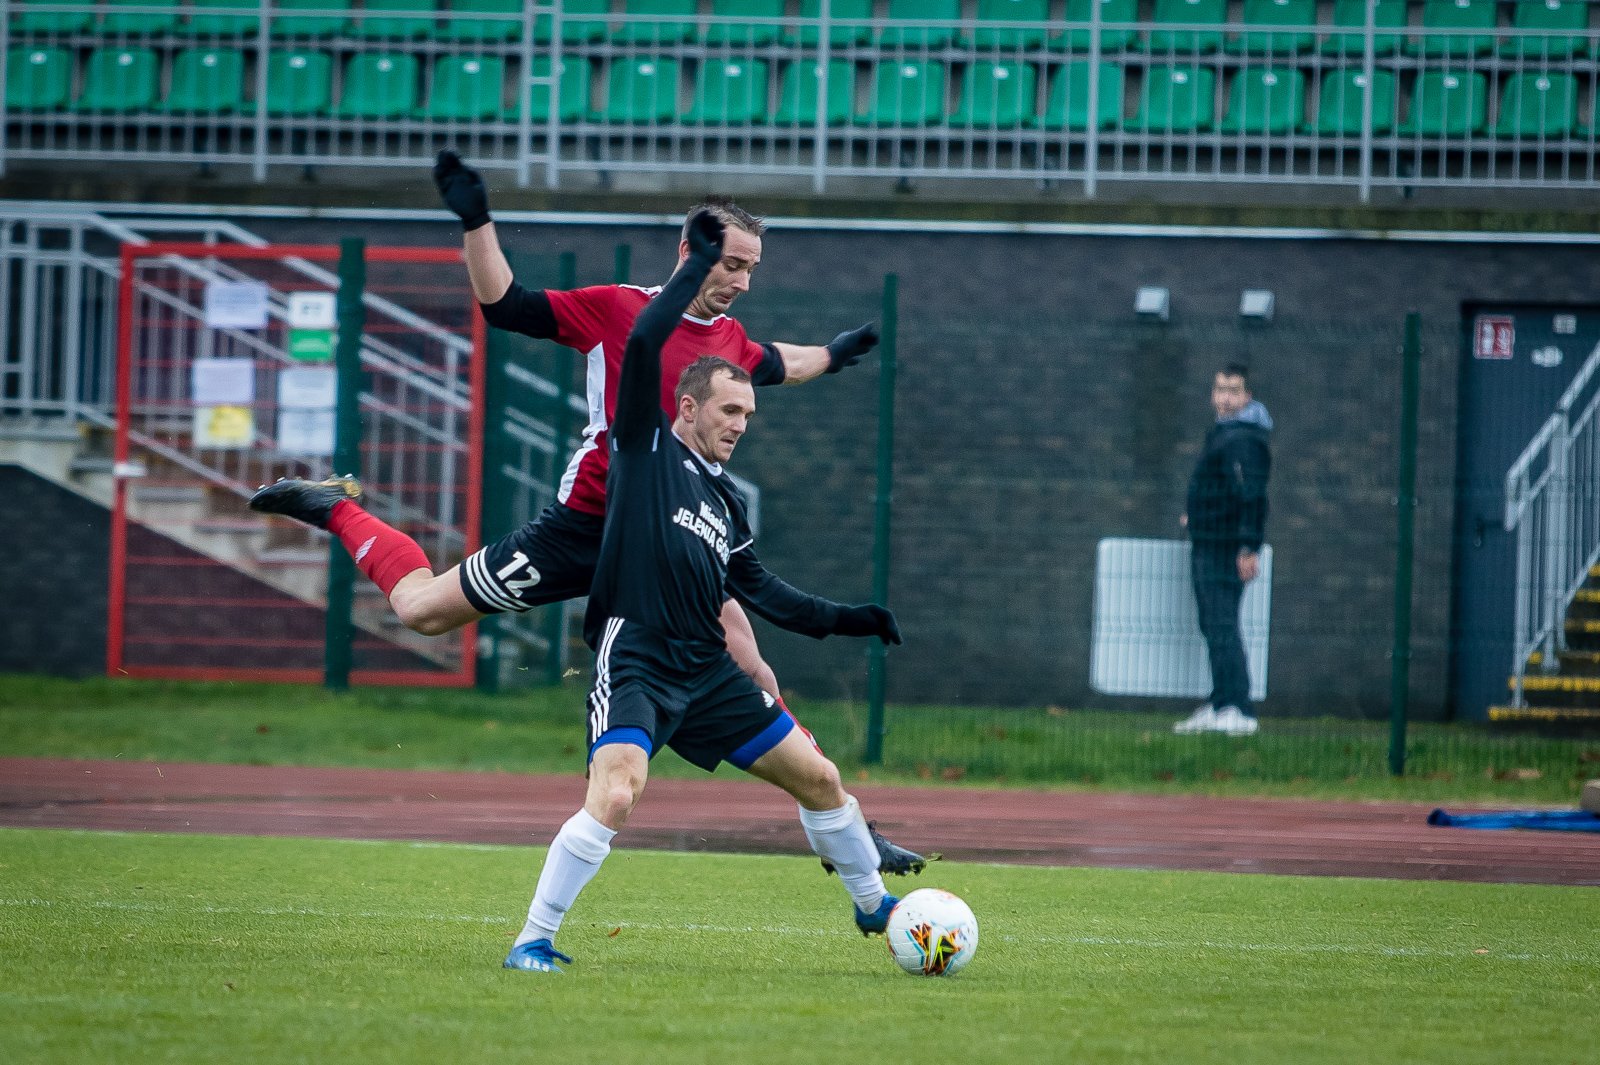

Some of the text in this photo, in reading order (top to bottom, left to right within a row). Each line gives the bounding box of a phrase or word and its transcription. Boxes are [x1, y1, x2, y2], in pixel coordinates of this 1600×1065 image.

[672, 507, 716, 548] JELENIA
[699, 500, 728, 538] Miasto
[495, 550, 542, 598] 12
